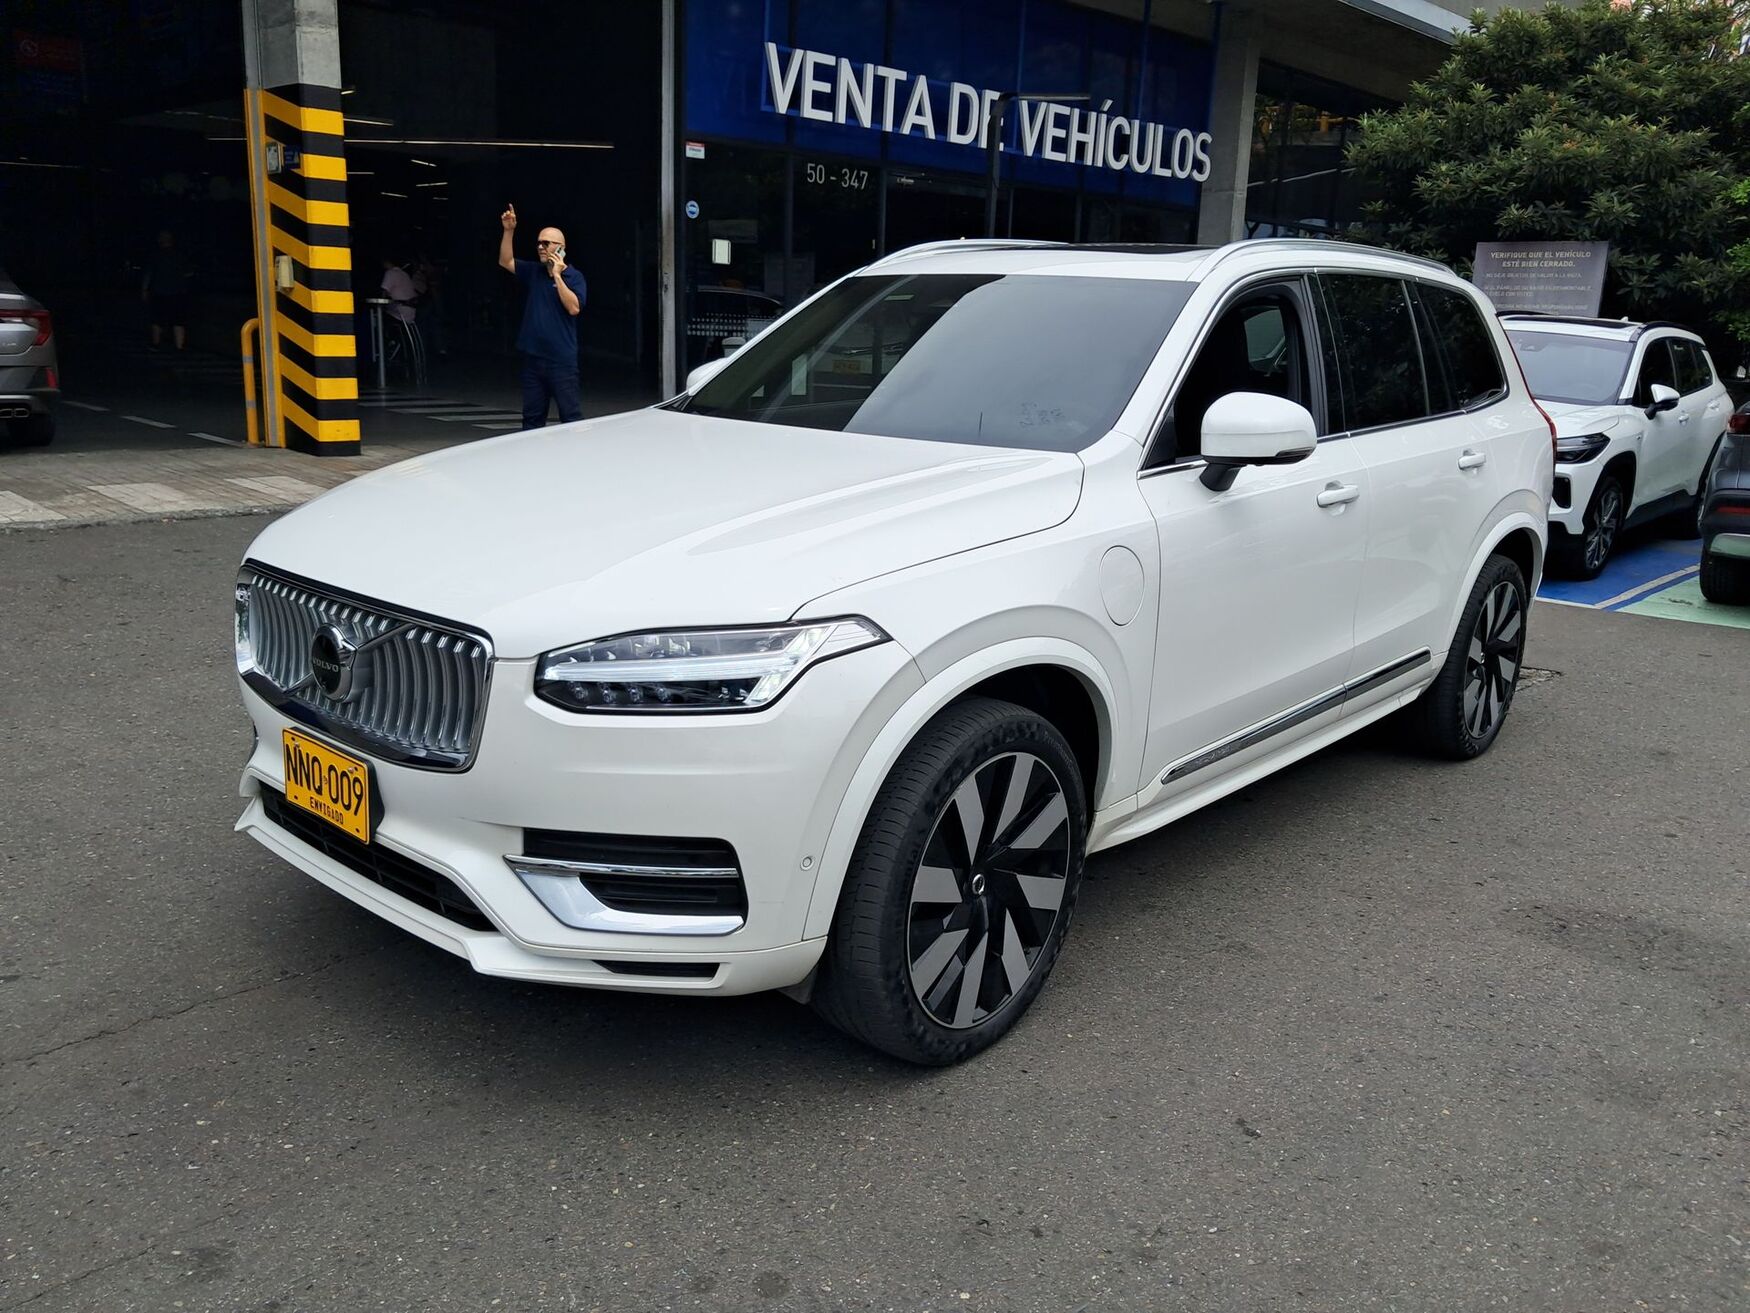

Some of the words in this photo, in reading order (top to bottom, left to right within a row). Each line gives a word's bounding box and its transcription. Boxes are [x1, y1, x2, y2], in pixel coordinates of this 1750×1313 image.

[764, 42, 936, 140] VENTA
[1018, 98, 1213, 183] VEHÍCULOS
[806, 162, 826, 185] 50
[840, 167, 869, 191] 347
[1490, 251, 1527, 259] VERIFIQUE
[1555, 249, 1592, 258] VEHÍCULO
[1502, 259, 1520, 268] ESTÉ
[312, 658, 340, 673] VOLVO
[309, 797, 344, 825] ENVIGADO
